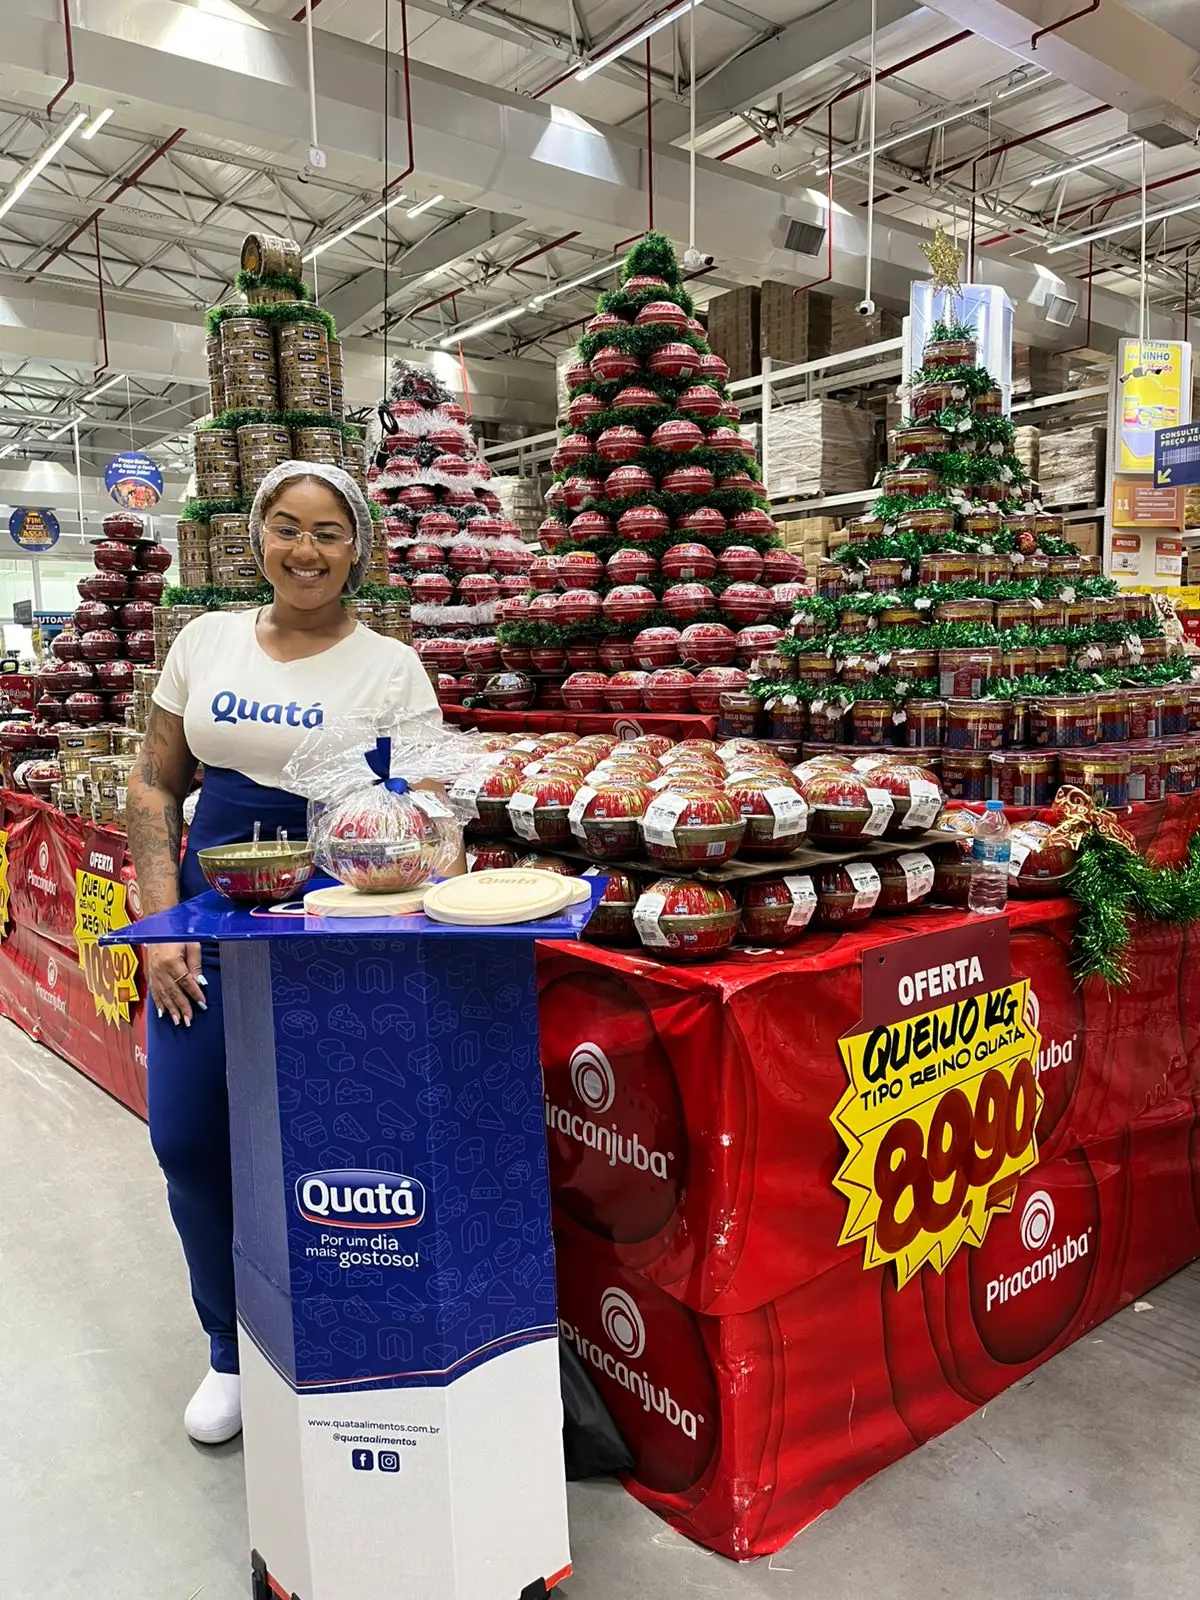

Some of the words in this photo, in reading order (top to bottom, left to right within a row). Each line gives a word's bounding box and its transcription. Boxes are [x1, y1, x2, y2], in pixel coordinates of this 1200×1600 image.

[1160, 427, 1199, 440] CONSULTE
[1160, 437, 1186, 447] PREÇO
[1116, 499, 1129, 510] 11
[211, 690, 324, 730] Quatá
[90, 852, 114, 874] OFERTA
[82, 873, 114, 906] QUEIJO
[79, 898, 97, 912] REINO
[81, 914, 113, 936] REGINA
[898, 956, 984, 1006] OFERTA
[862, 1002, 982, 1084] QUEIJO
[982, 988, 1018, 1033] KG
[859, 1078, 903, 1111] TIPO
[910, 1050, 972, 1086] REINO
[974, 1026, 1025, 1061] QUATA
[545, 1094, 674, 1180] iracanjuba
[302, 1179, 416, 1216] Quatá
[321, 1234, 344, 1246] Por
[346, 1237, 368, 1247] um
[370, 1234, 399, 1251] dia
[306, 1246, 337, 1257] mais
[339, 1250, 419, 1268] gostoso!
[986, 1226, 1092, 1312] Piracanjuba
[308, 1418, 440, 1434] www.quataalimentos.com.br
[333, 1433, 417, 1447] @quataalimentos
